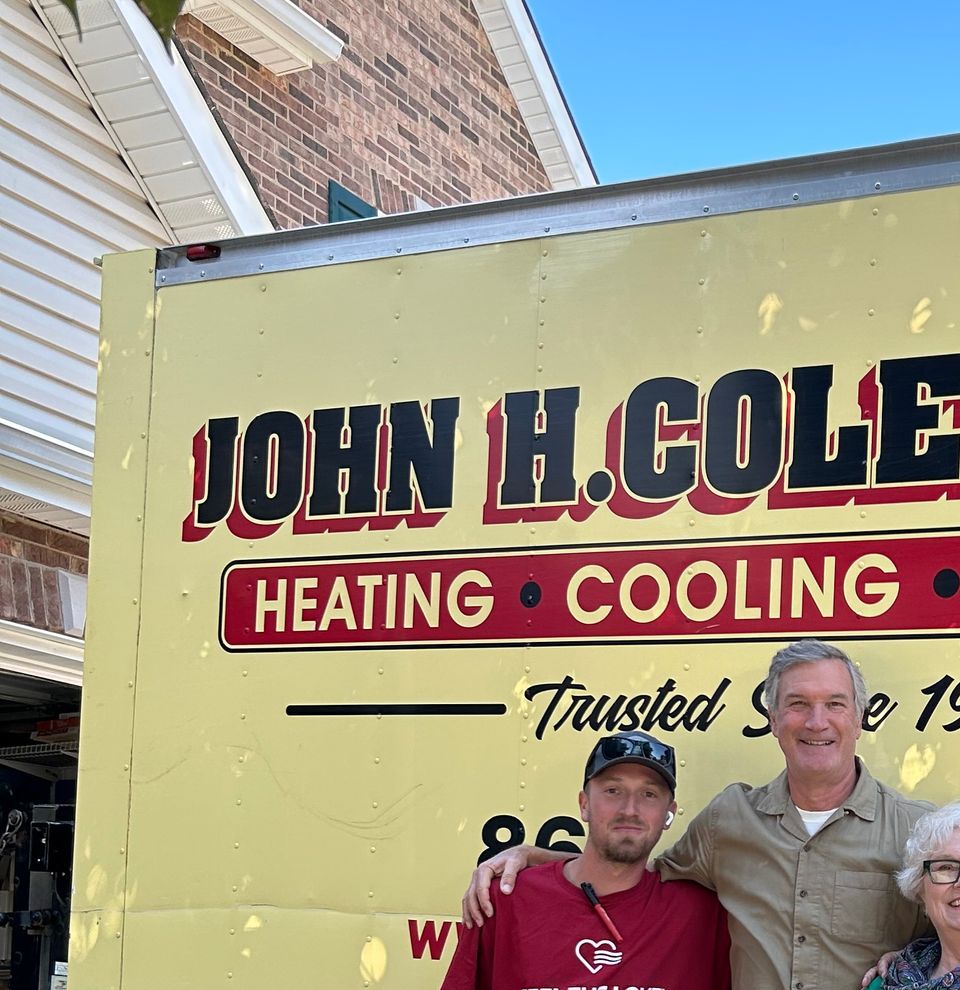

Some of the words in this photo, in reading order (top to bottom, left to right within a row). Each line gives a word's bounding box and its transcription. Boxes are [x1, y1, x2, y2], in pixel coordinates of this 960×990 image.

[182, 396, 460, 542] JOHN
[254, 568, 495, 633] HEATING
[566, 552, 900, 626] COOLING
[524, 674, 733, 741] Trusted
